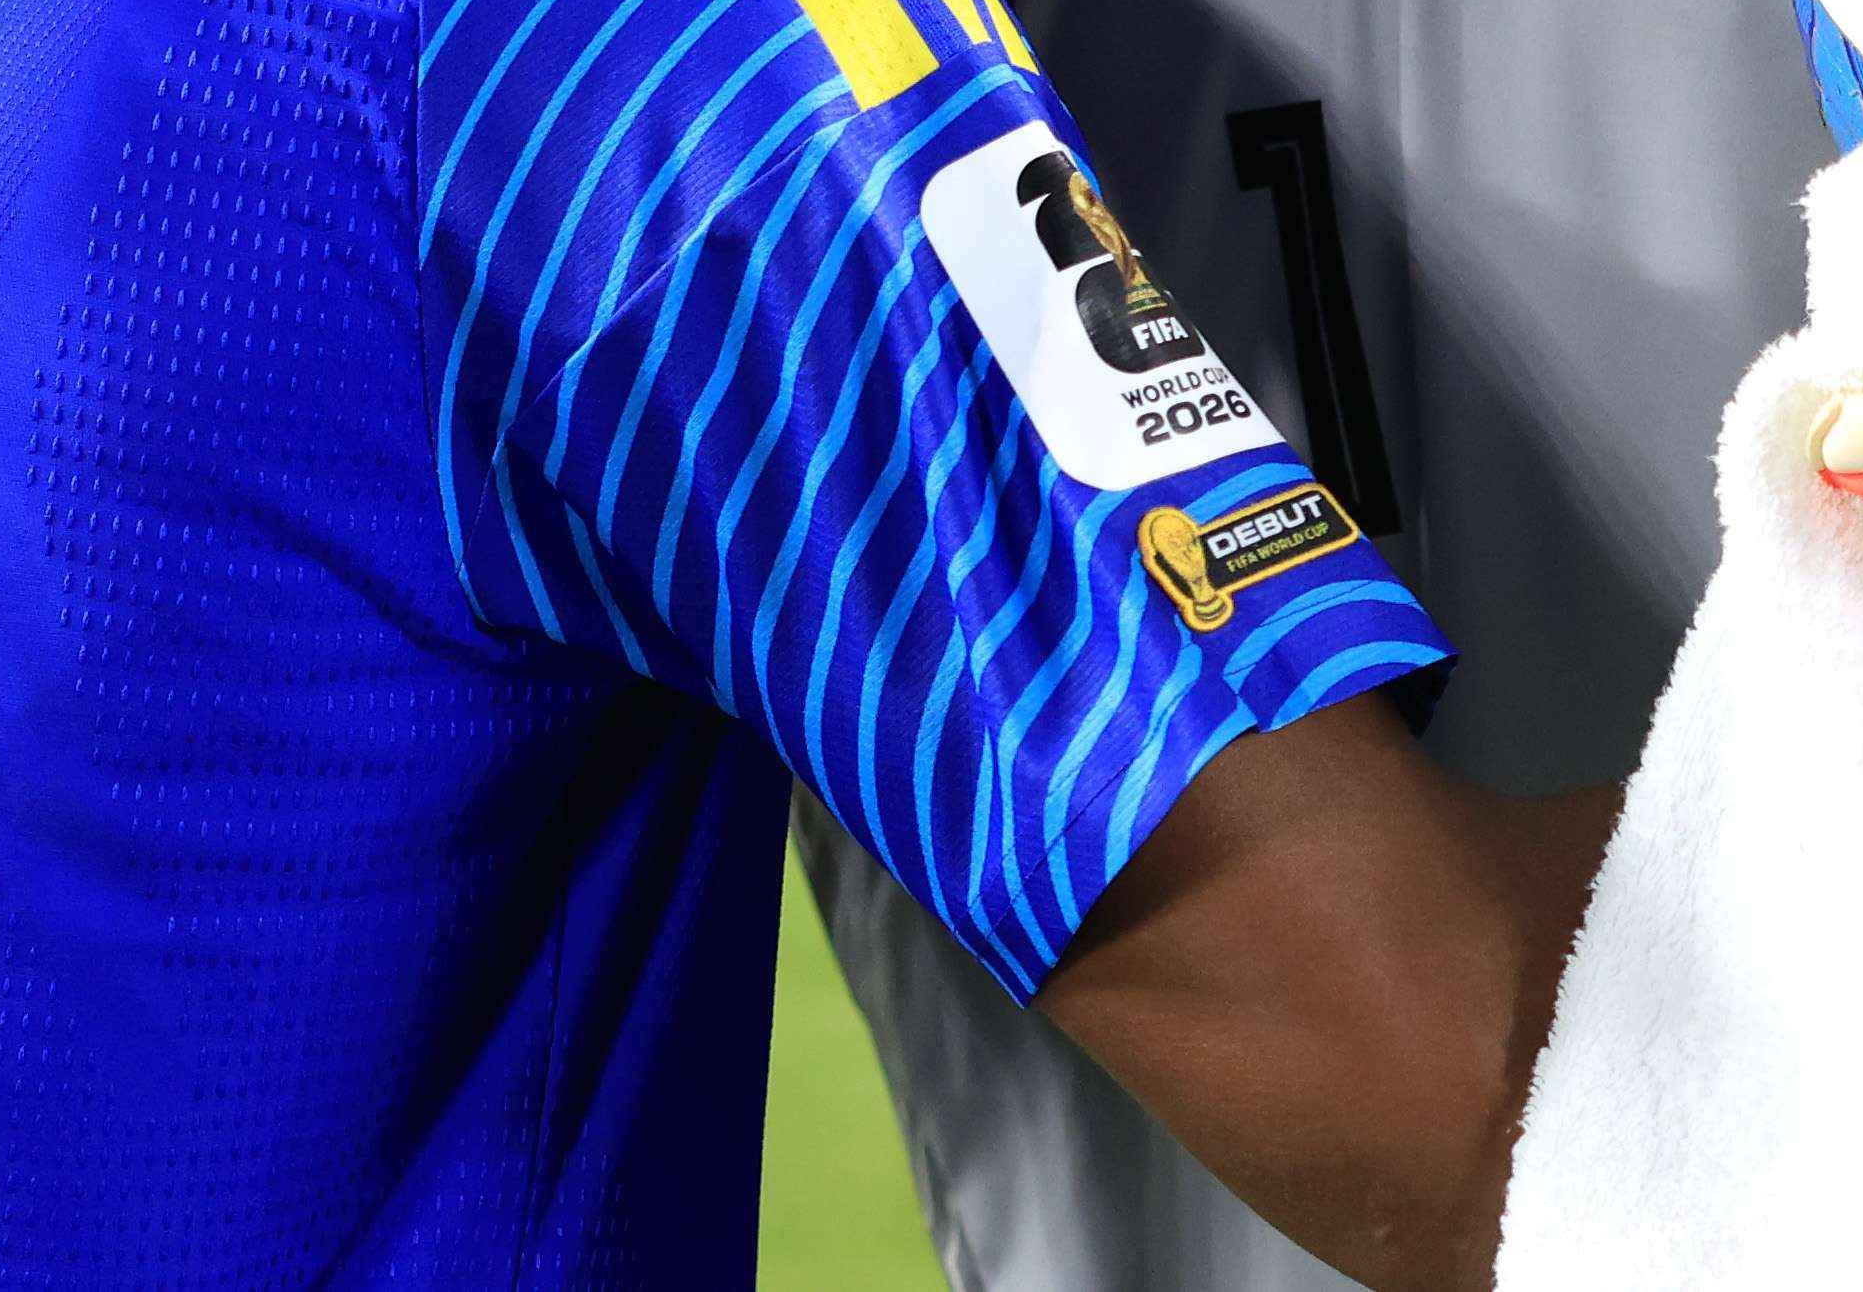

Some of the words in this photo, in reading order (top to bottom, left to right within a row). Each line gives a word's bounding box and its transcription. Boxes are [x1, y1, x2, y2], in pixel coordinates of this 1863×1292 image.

[1131, 316, 1189, 350] FIFA
[1226, 100, 1402, 537] 1
[1121, 371, 1202, 409] WORLD
[1202, 368, 1229, 386] CUP
[1136, 390, 1252, 446] 2026
[1207, 494, 1323, 560] DEBUT
[1226, 554, 1258, 573] FIFA
[1259, 533, 1304, 562] WORLD
[1303, 520, 1330, 541] CUP
